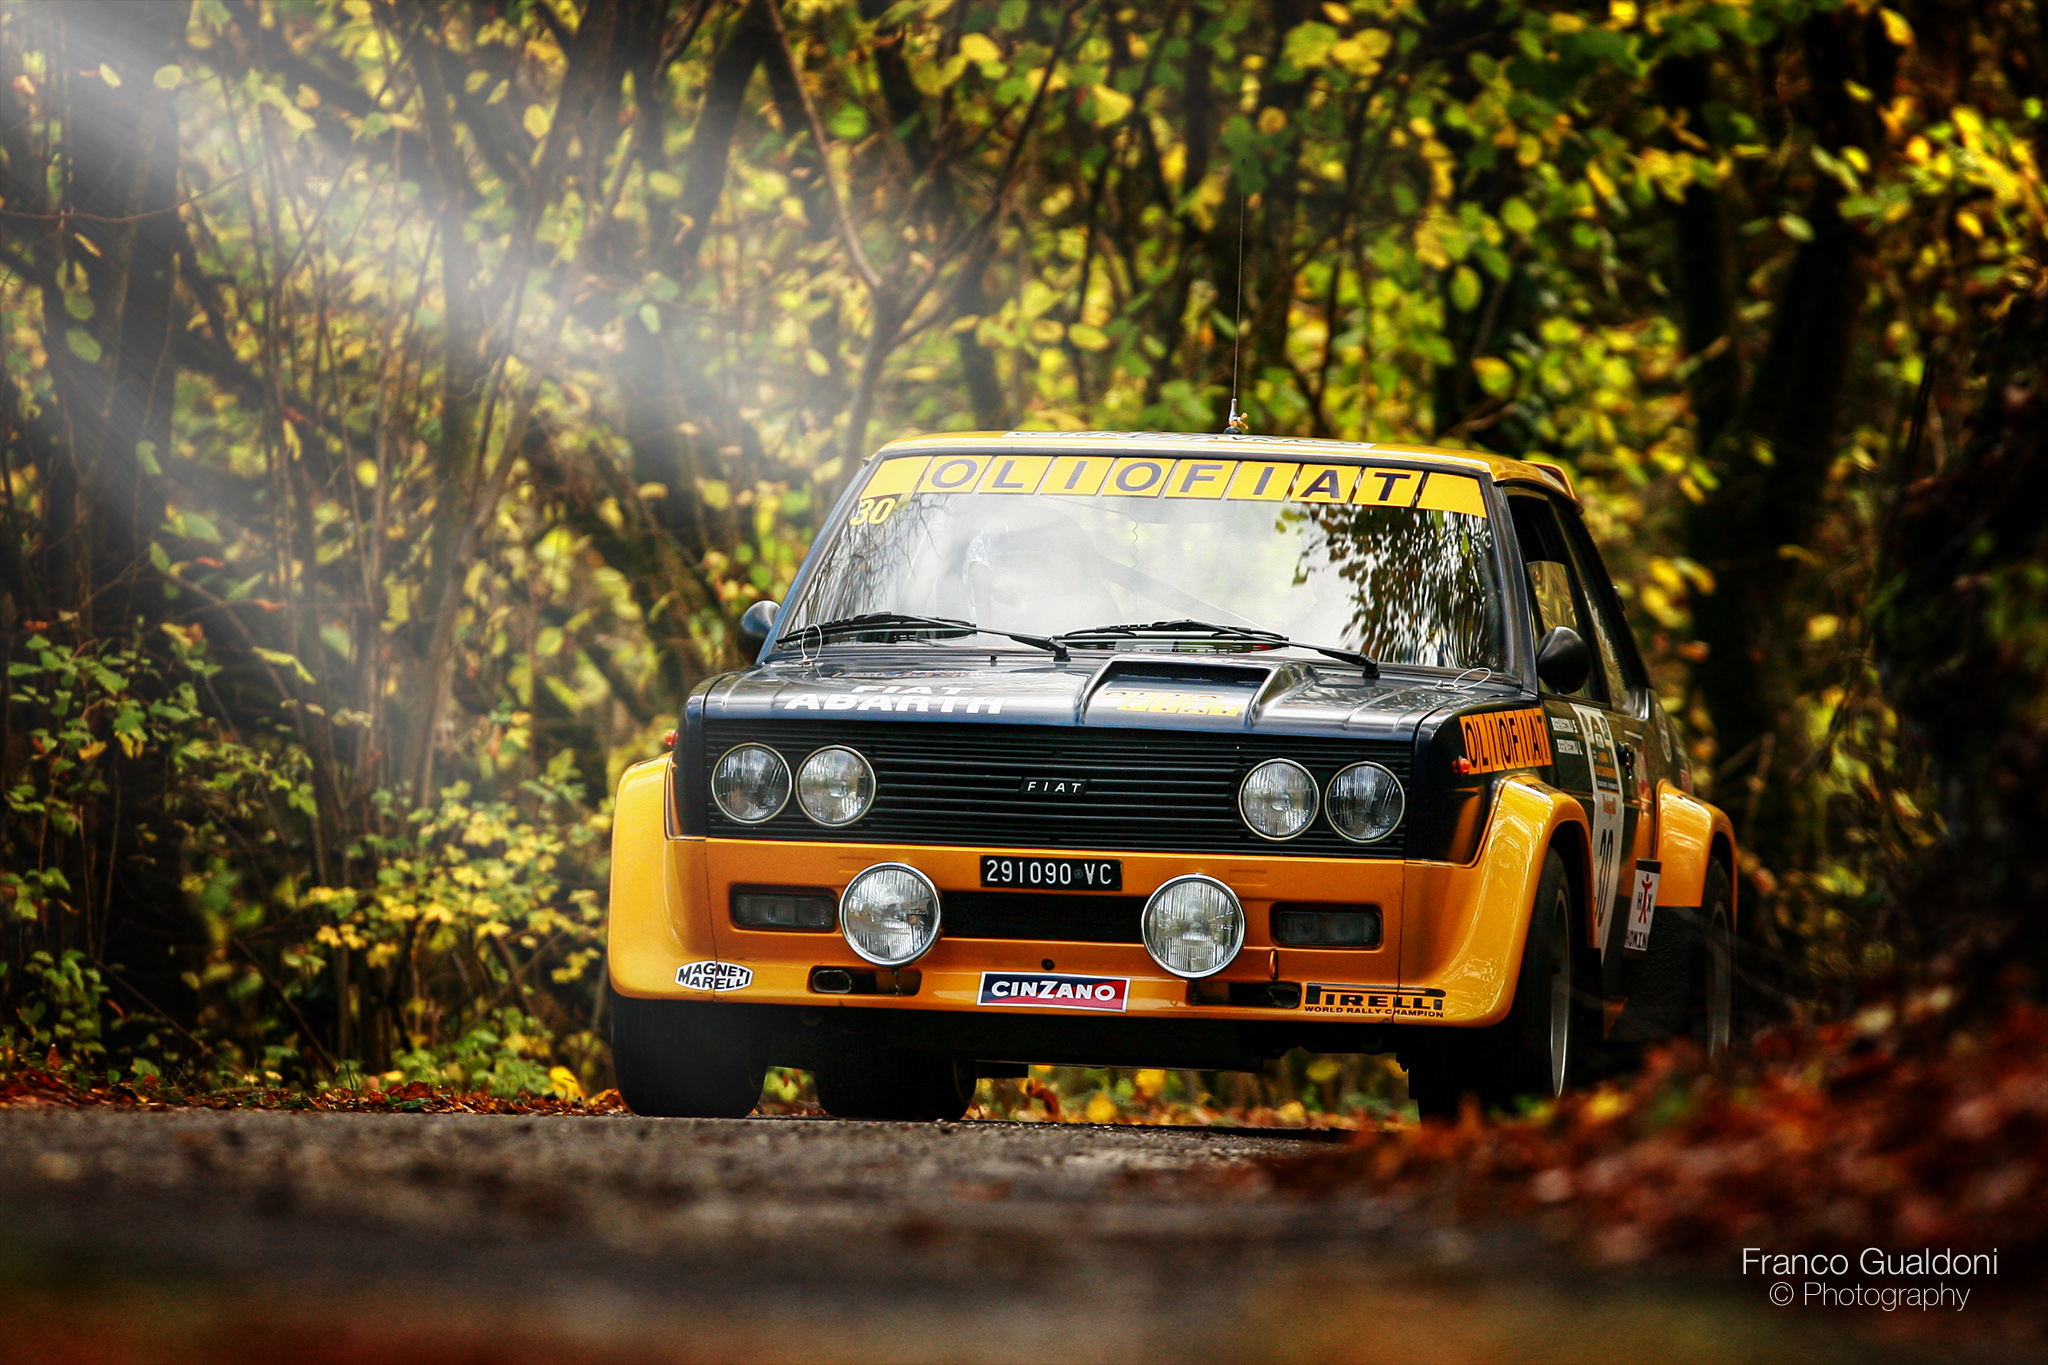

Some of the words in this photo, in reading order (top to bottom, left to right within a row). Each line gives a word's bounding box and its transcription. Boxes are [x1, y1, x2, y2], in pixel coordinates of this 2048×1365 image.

[931, 459, 1411, 502] OLIOFIAT
[850, 498, 896, 526] 30
[850, 685, 975, 695] FIAT
[784, 693, 1007, 715] ABARTH
[1464, 715, 1549, 769] OLIOFIAT
[1027, 781, 1082, 794] FIAT
[986, 859, 1072, 885] 291090
[1084, 863, 1112, 885] VC
[678, 962, 751, 984] MAGNETI
[678, 975, 750, 990] MARELLI
[991, 980, 1117, 1001] CINZANO
[1305, 983, 1447, 1011] PIRELLI
[1346, 1007, 1382, 1015] RALLY
[1384, 1009, 1444, 1018] CHAMPION
